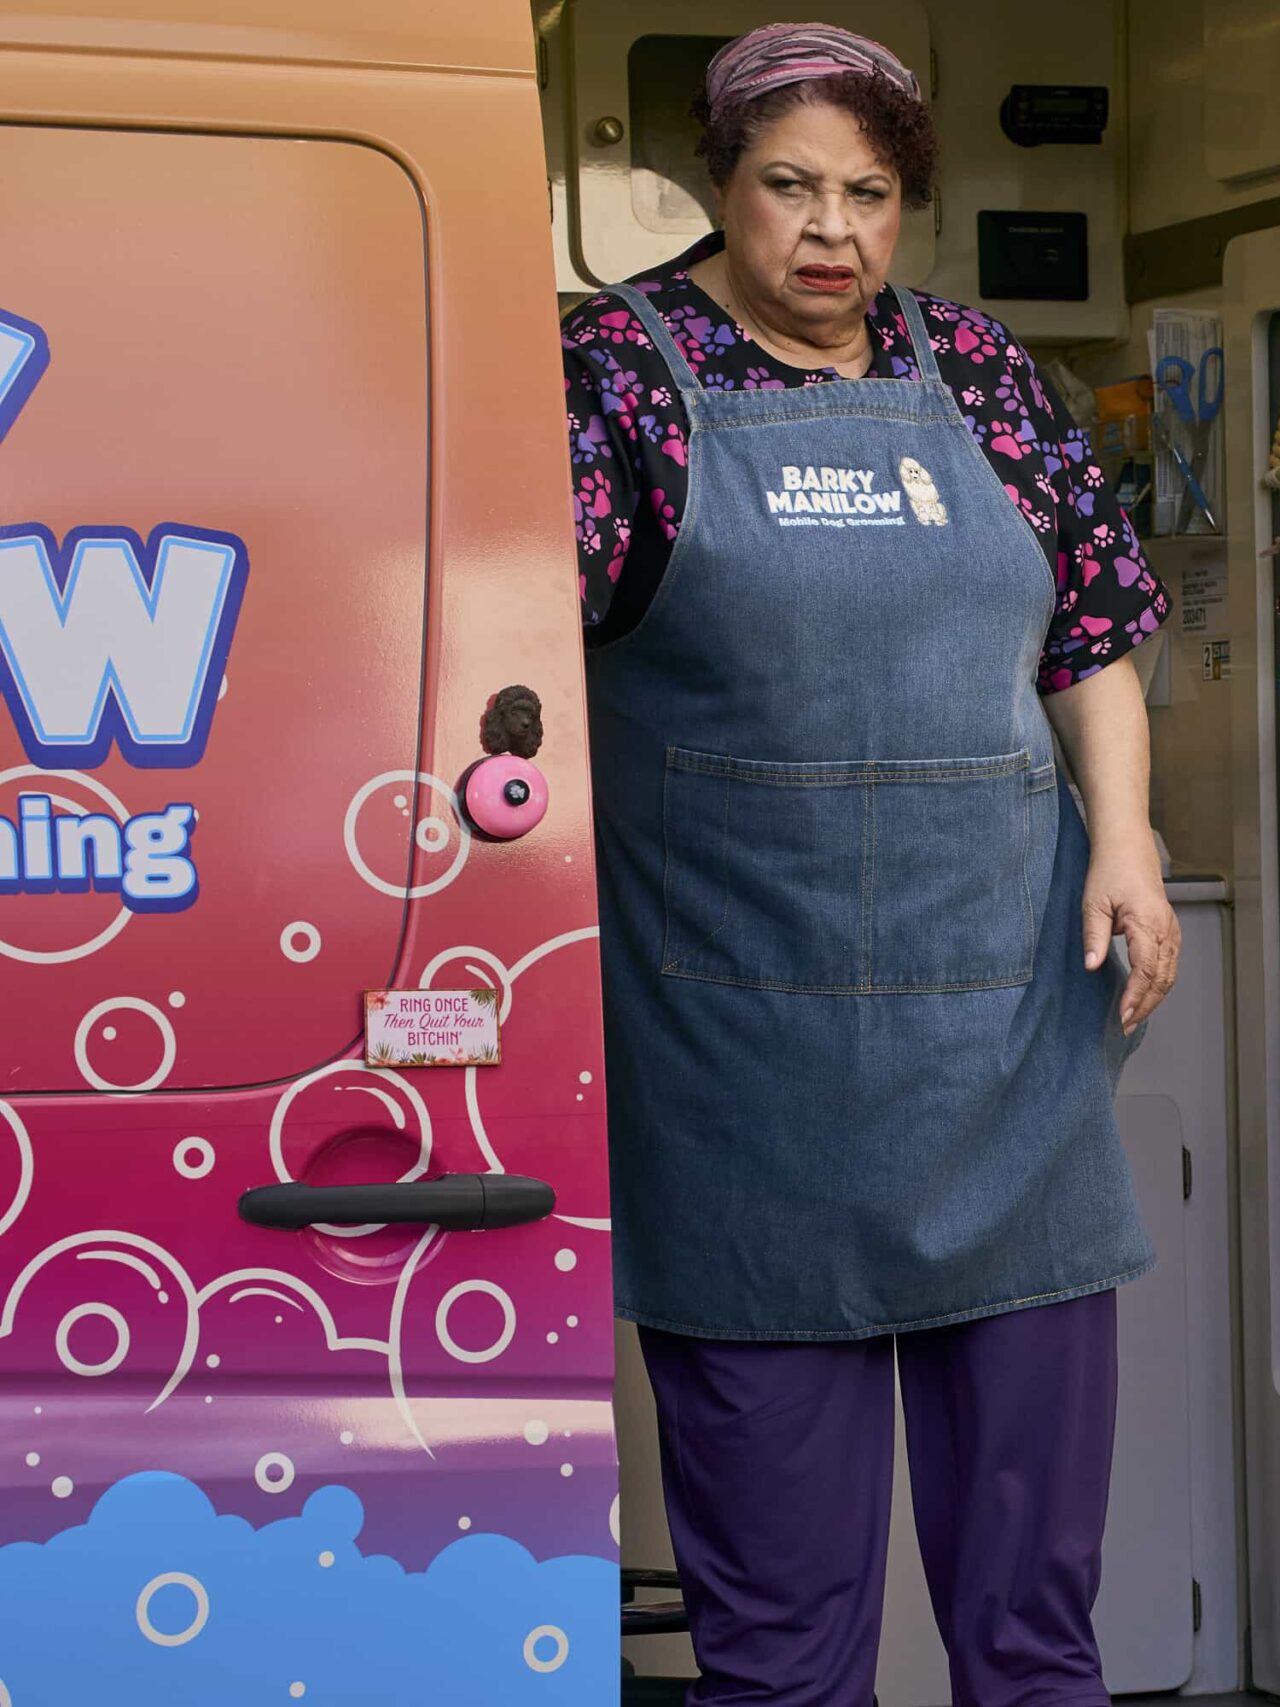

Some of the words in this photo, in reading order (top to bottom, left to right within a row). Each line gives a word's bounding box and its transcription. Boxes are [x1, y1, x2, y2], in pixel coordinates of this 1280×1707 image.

[782, 466, 875, 493] BARKY
[766, 490, 901, 514] MANILOW
[778, 517, 820, 527] Mobile
[821, 517, 846, 528] Dog
[846, 516, 906, 527] Grooming
[400, 998, 431, 1012] RING
[434, 998, 469, 1012] ONCE
[383, 1013, 415, 1029] Then
[418, 1012, 450, 1030] Quit
[453, 1012, 485, 1028] Your
[407, 1031, 462, 1046] BITCHIN'
